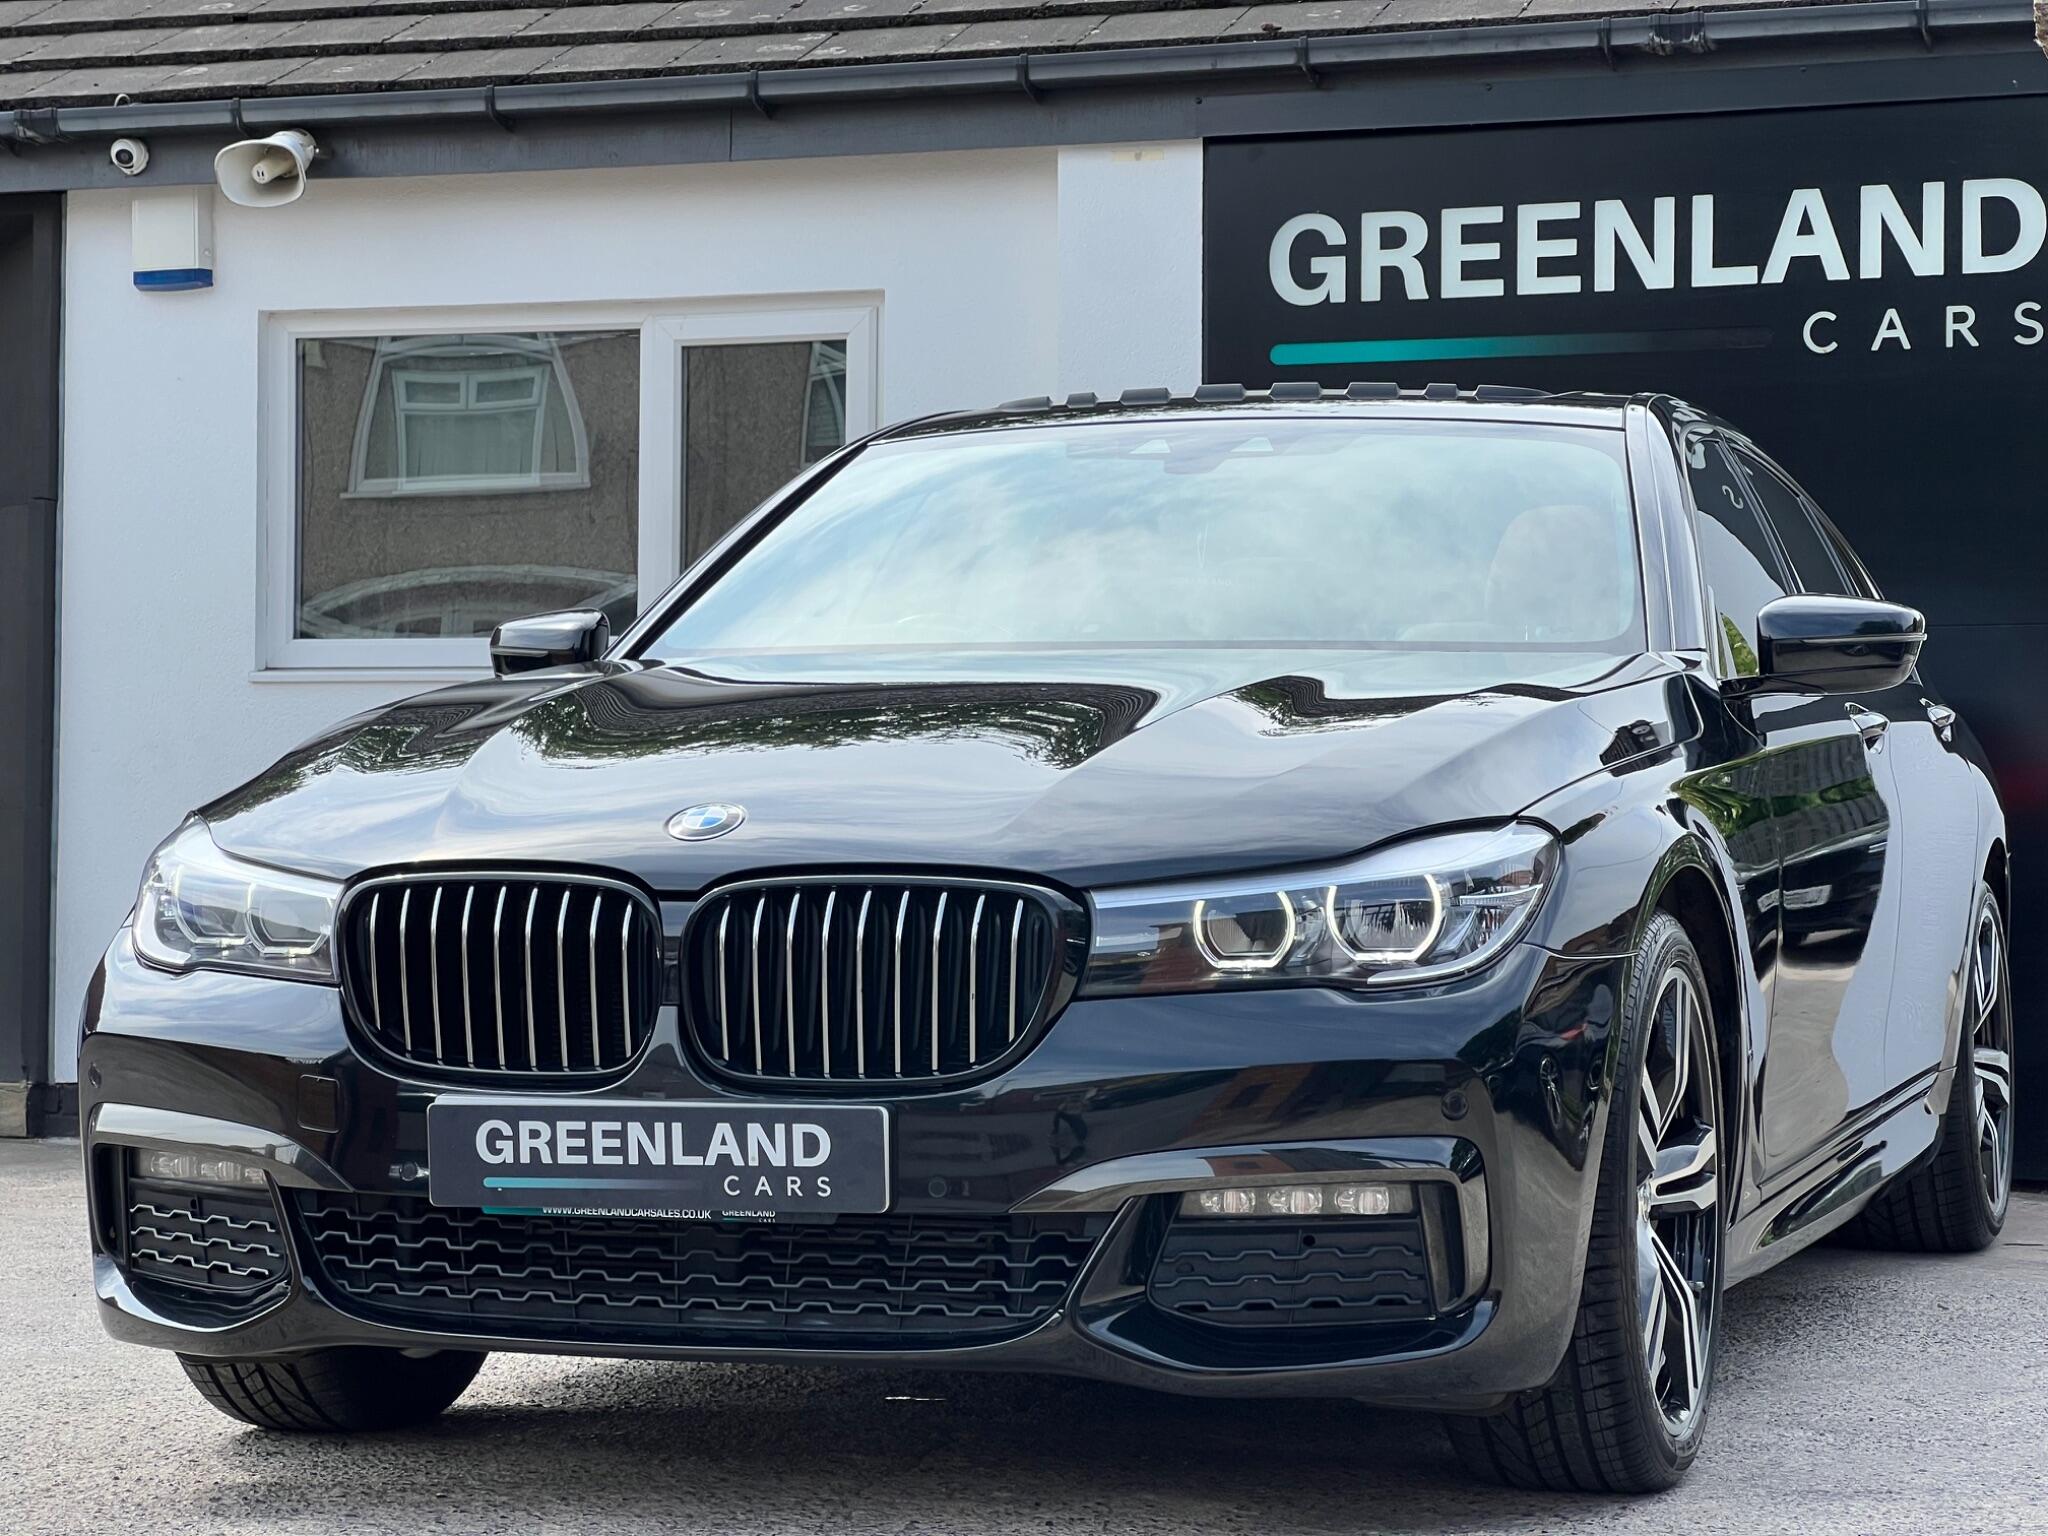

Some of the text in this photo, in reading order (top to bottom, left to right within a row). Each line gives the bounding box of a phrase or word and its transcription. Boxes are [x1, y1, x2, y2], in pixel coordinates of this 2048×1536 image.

[1269, 178, 2048, 307] GREENLAND
[1803, 301, 2045, 353] CARS
[475, 1120, 832, 1168] GREENLAND
[724, 1175, 832, 1198] CARS
[542, 1206, 712, 1220] WWW.GREENLANDCARSALES.CO.UK
